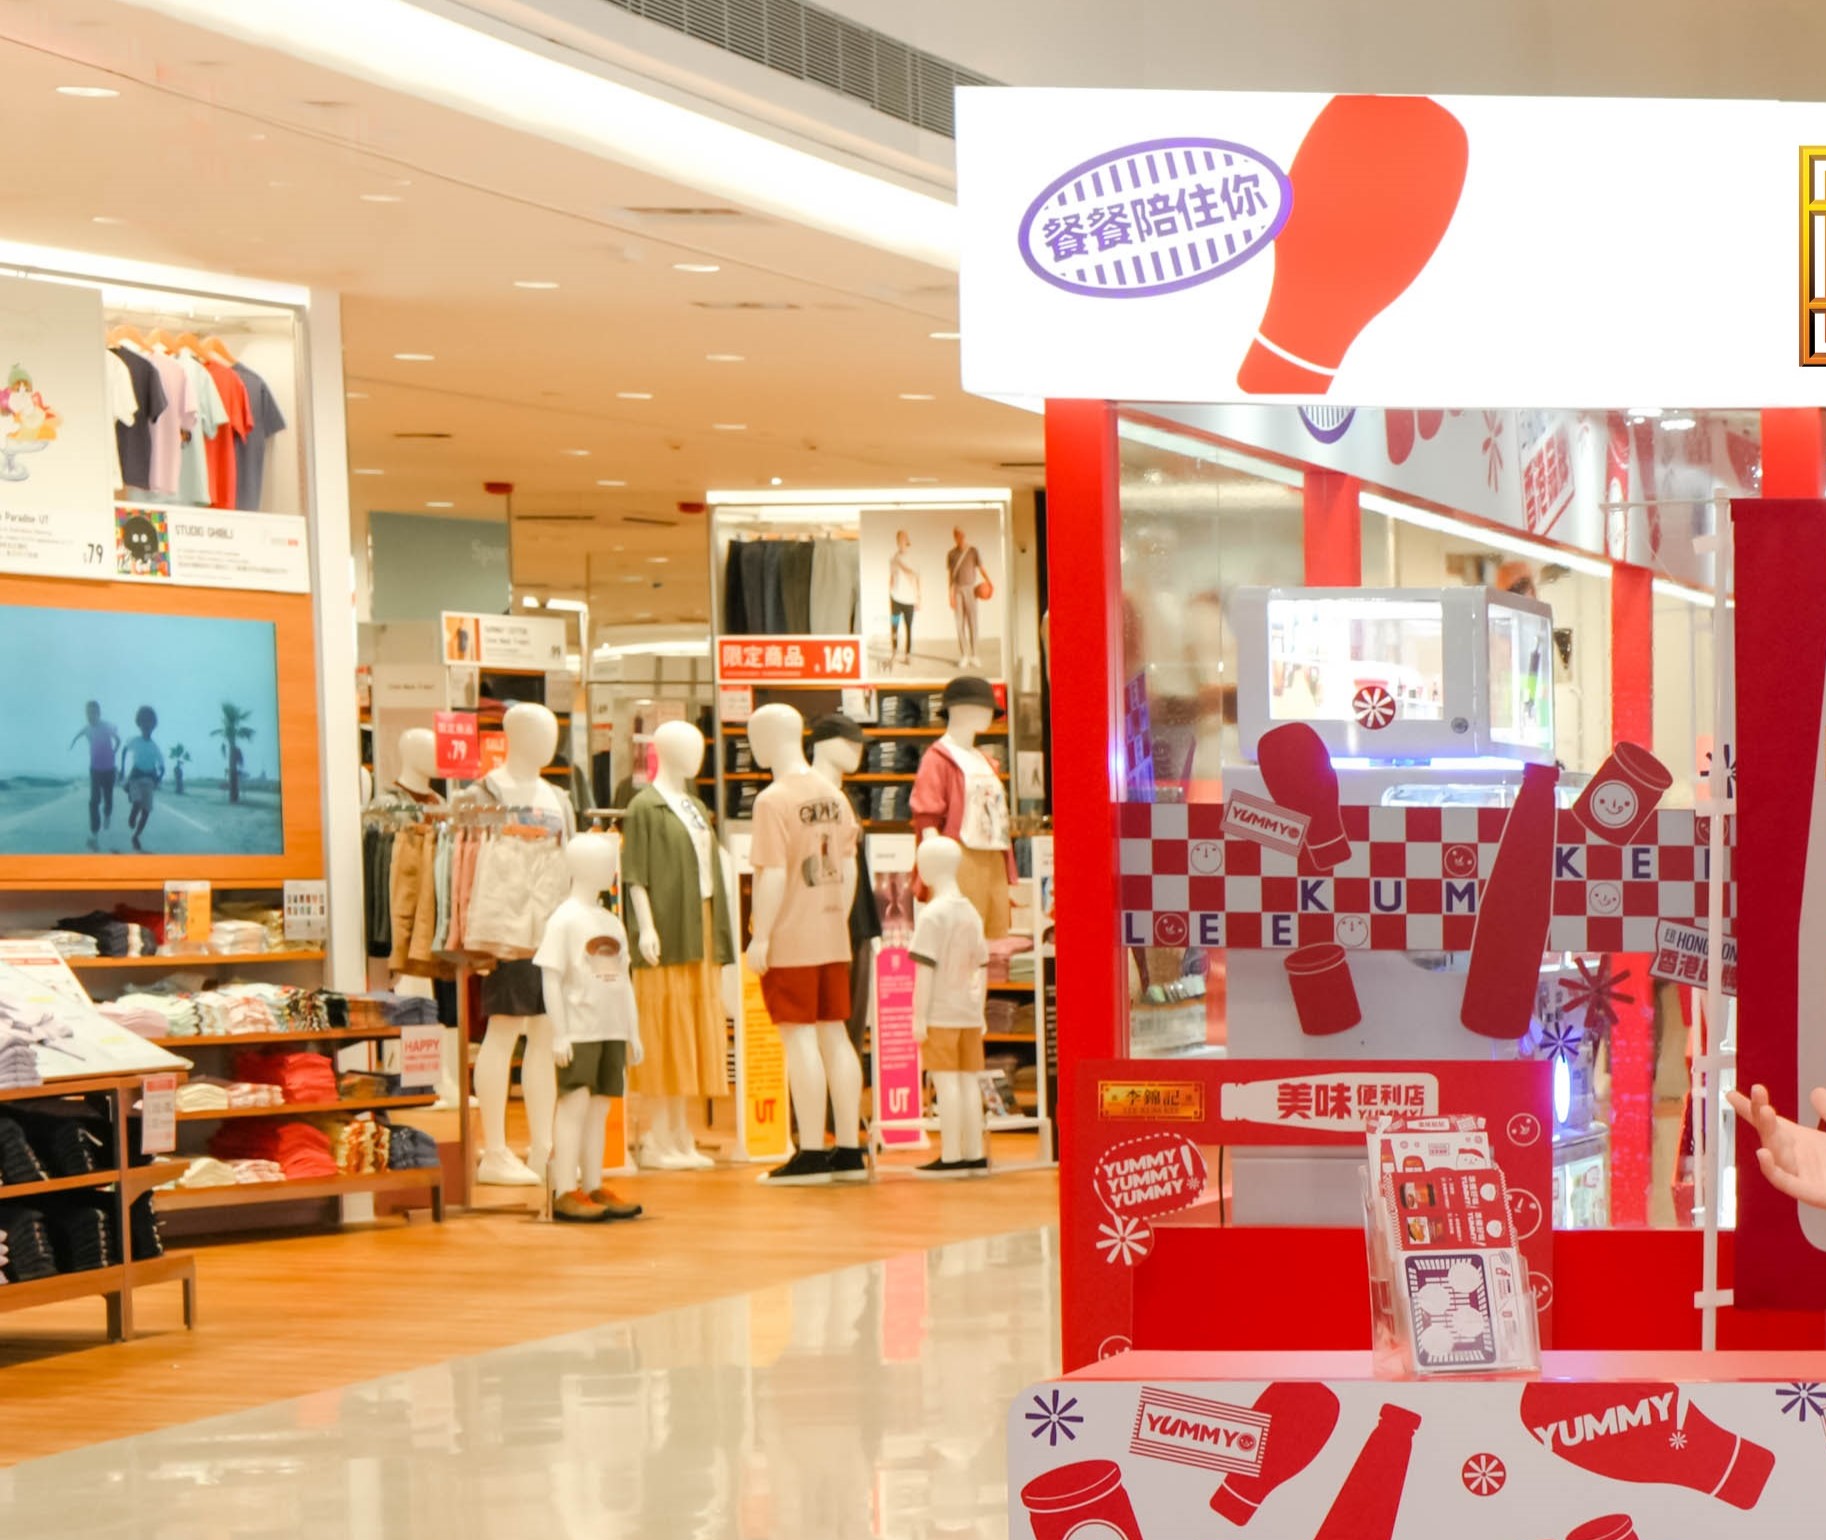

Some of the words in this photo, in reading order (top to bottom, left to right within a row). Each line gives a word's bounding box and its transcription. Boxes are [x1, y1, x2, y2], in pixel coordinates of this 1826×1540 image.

[1041, 174, 1268, 262] 餐餐陪住你
[722, 644, 805, 669] 限定商品
[889, 1086, 911, 1114] UT
[1146, 1411, 1240, 1450] YUMMY
